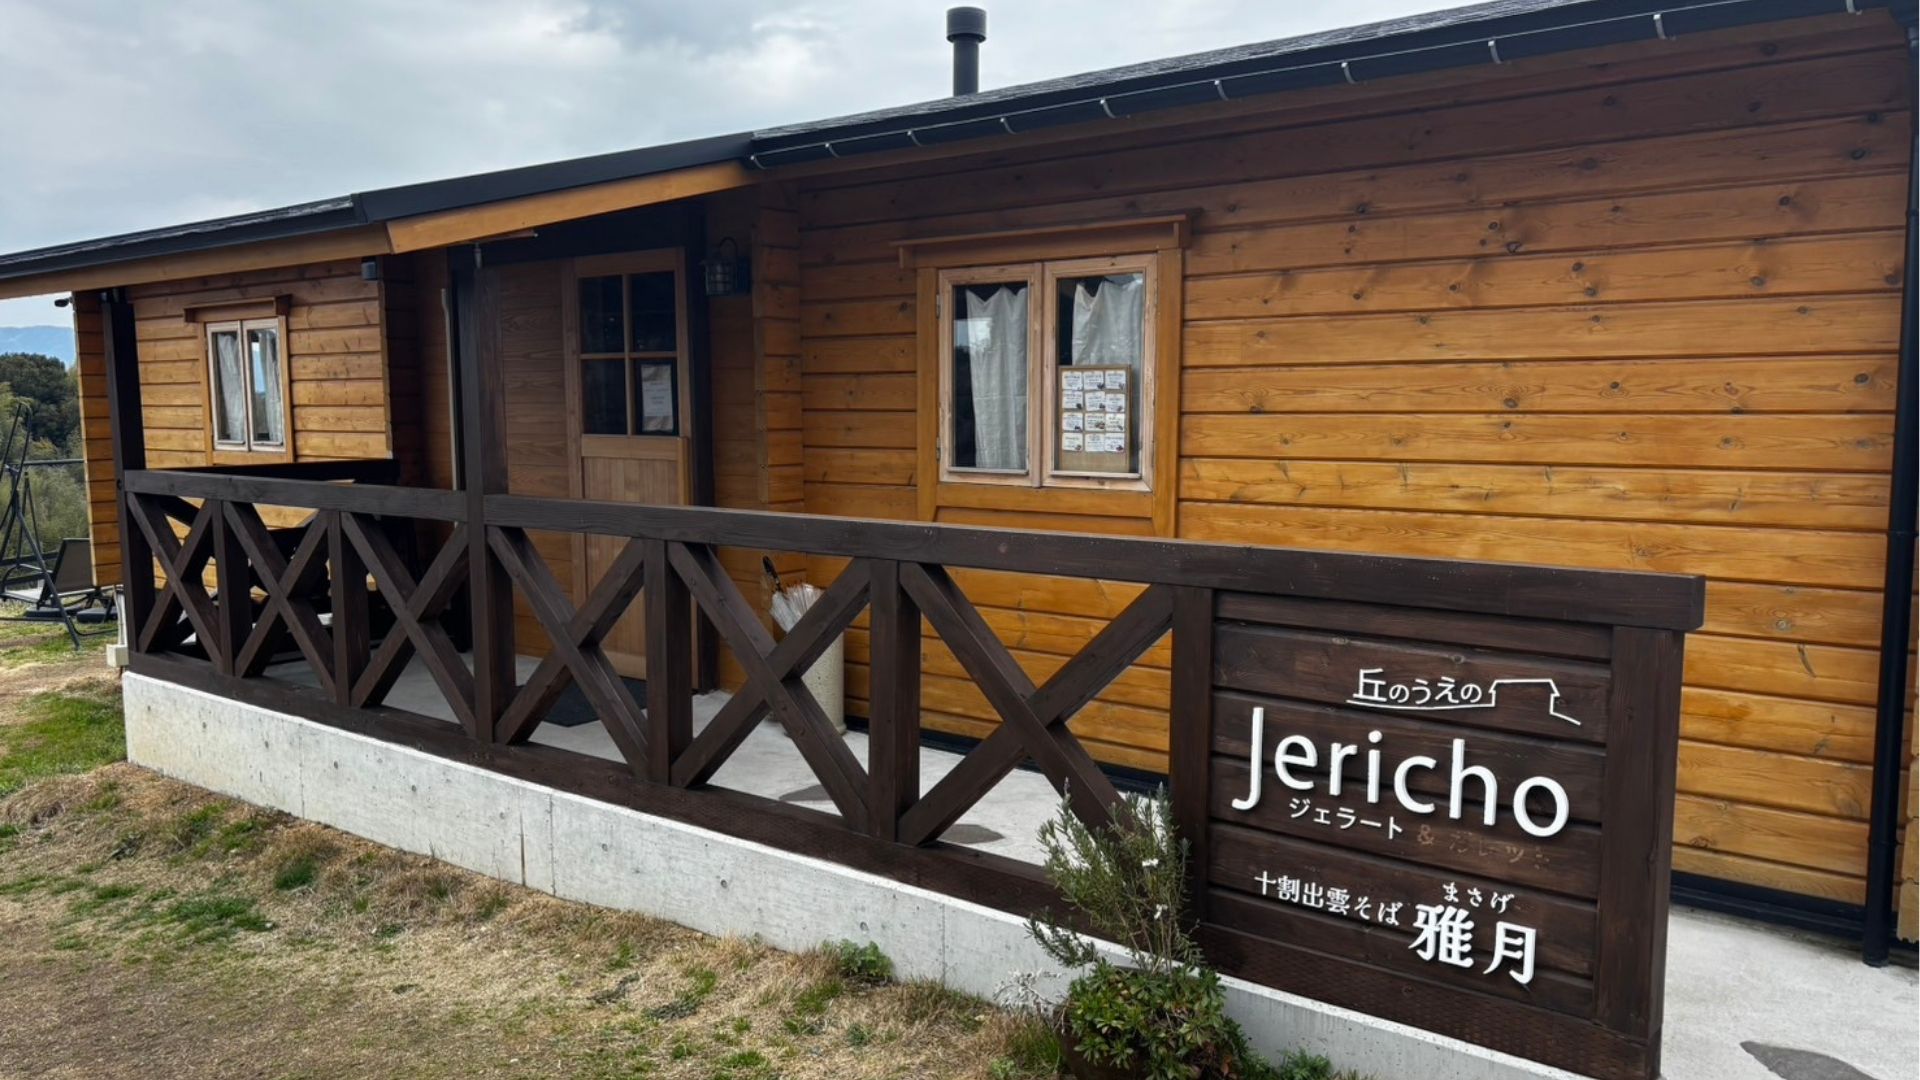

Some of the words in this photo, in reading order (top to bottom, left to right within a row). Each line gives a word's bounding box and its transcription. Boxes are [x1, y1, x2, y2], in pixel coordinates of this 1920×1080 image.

[1353, 667, 1484, 705] 丘のうえの
[1231, 706, 1570, 838] Jericho
[1288, 797, 1404, 840] ジェラート
[1442, 881, 1516, 914] まさげ
[1254, 870, 1402, 926] 十割出雲そば
[1408, 903, 1537, 985] 雅月
